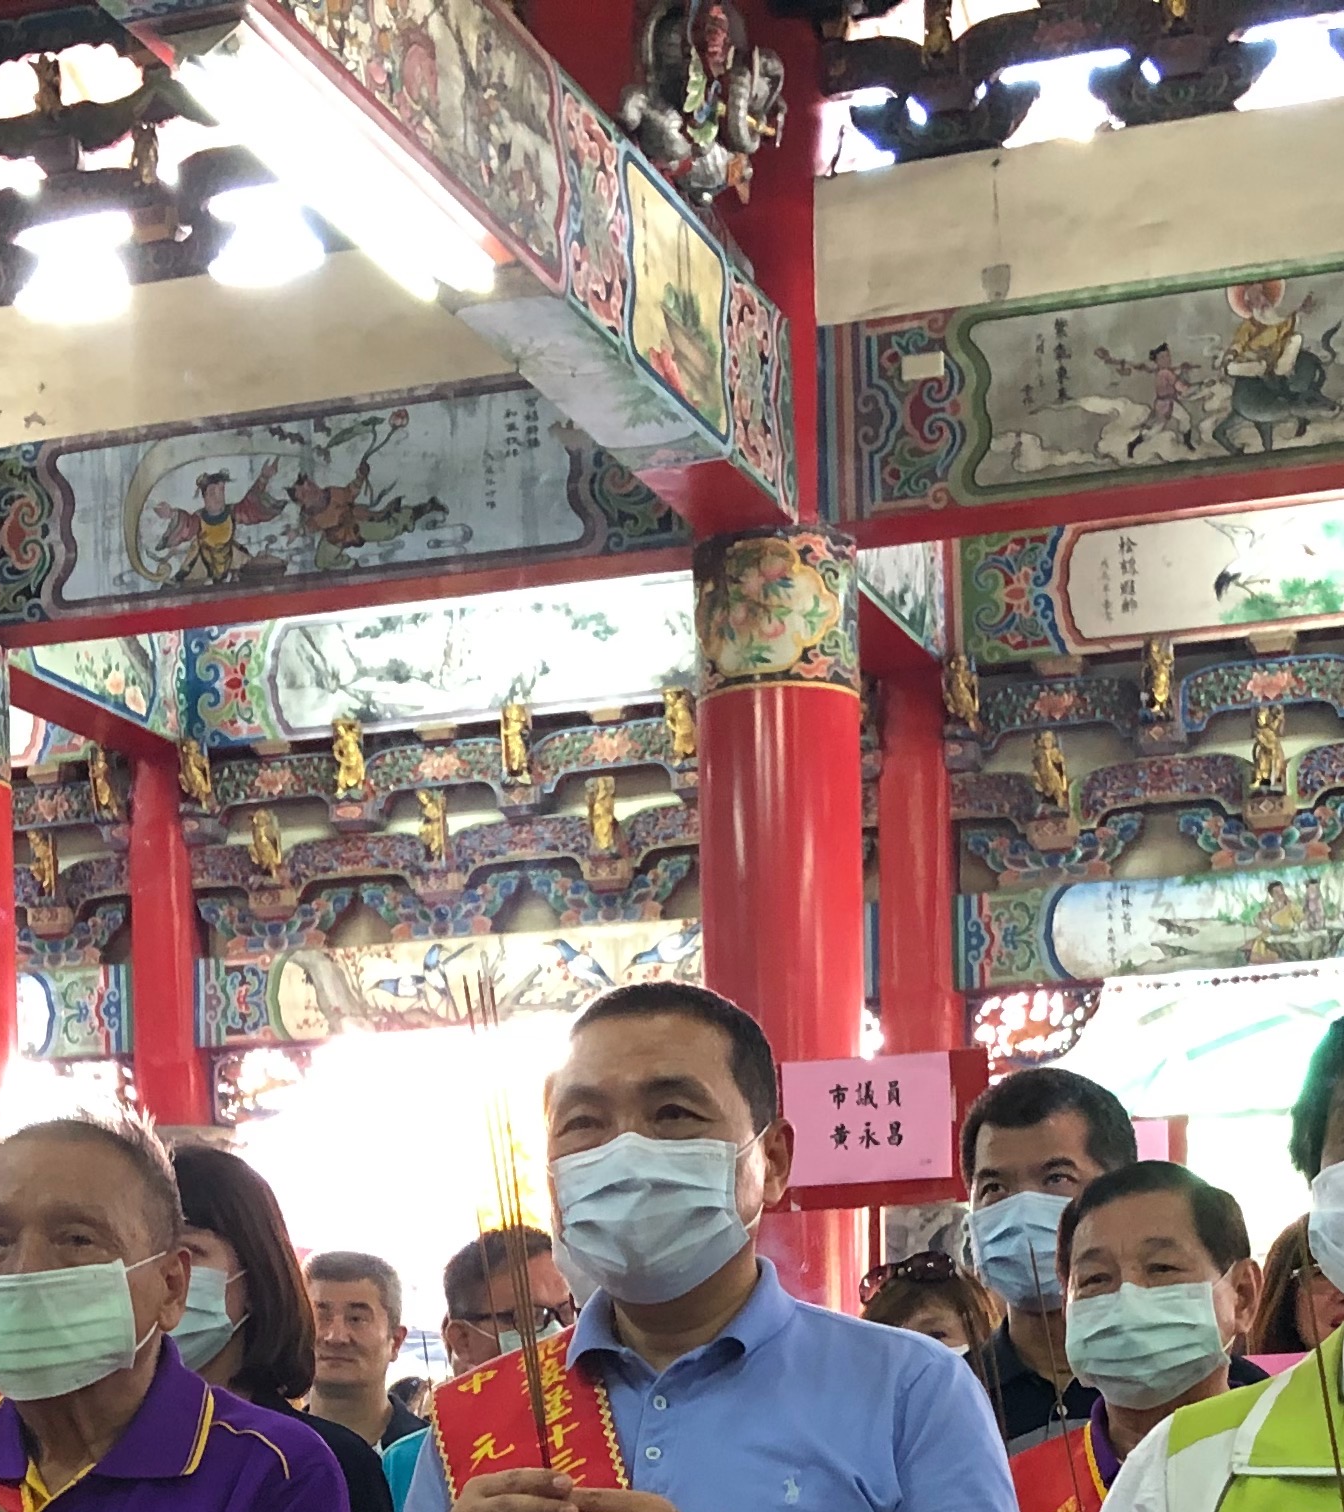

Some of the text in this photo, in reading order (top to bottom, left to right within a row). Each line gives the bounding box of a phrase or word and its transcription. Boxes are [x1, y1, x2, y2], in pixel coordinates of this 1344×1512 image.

[828, 1080, 902, 1110] 市議員
[829, 1120, 904, 1151] 黃永昌
